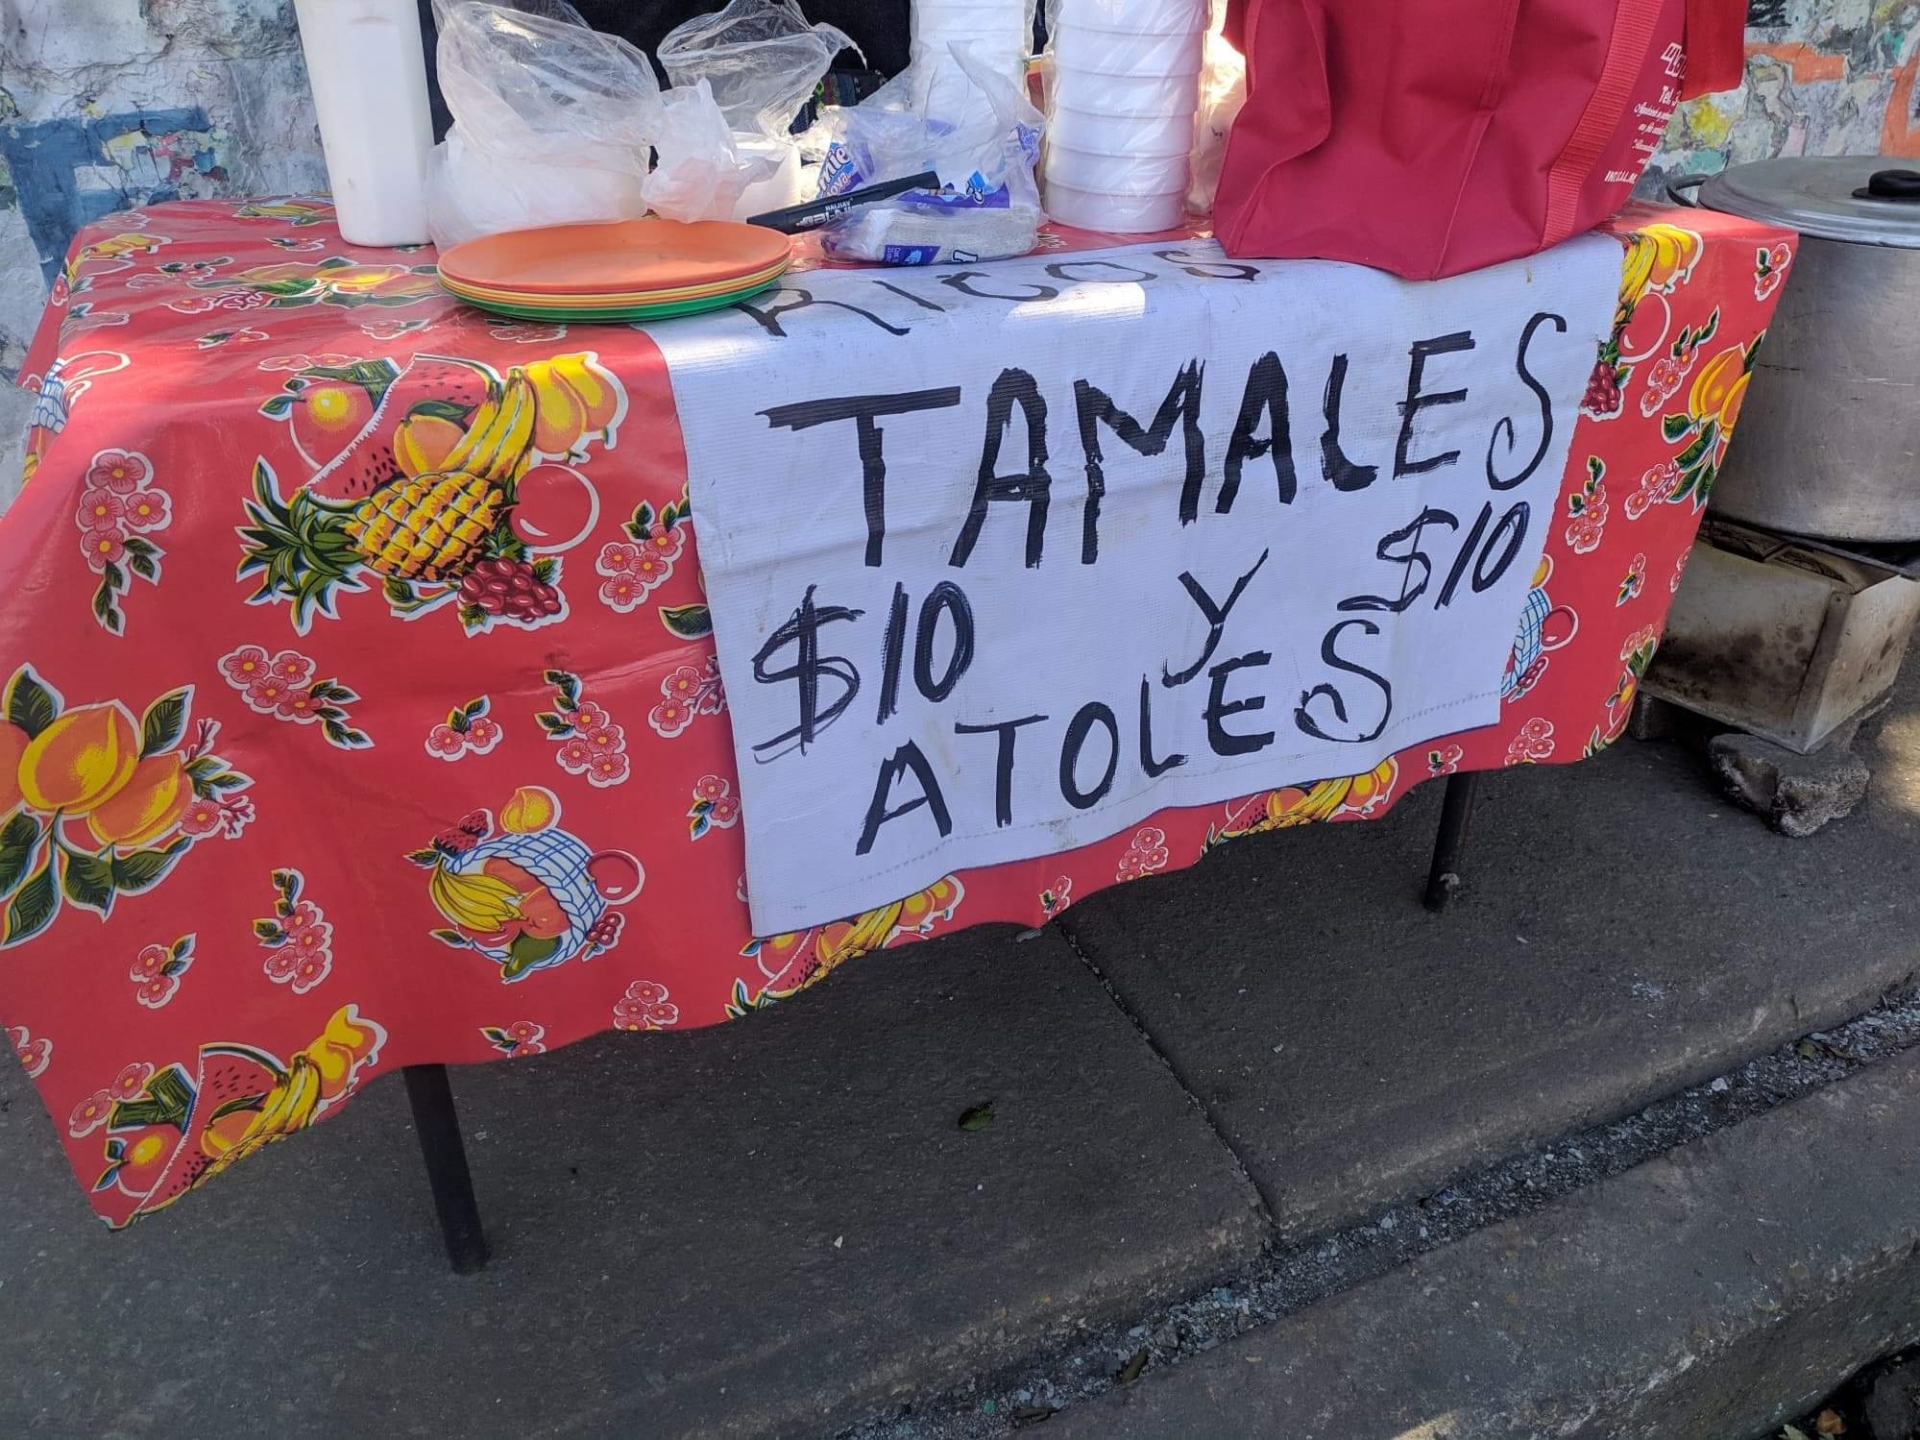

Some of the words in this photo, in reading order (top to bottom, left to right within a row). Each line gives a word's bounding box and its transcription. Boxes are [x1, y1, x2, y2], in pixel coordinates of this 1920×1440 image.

[735, 250, 1262, 337] RICOS
[757, 312, 1567, 569] TAMALES
[751, 580, 975, 765] $10
[1162, 547, 1269, 687] Y
[1337, 501, 1531, 613] $10
[855, 619, 1393, 856] ATOLES
